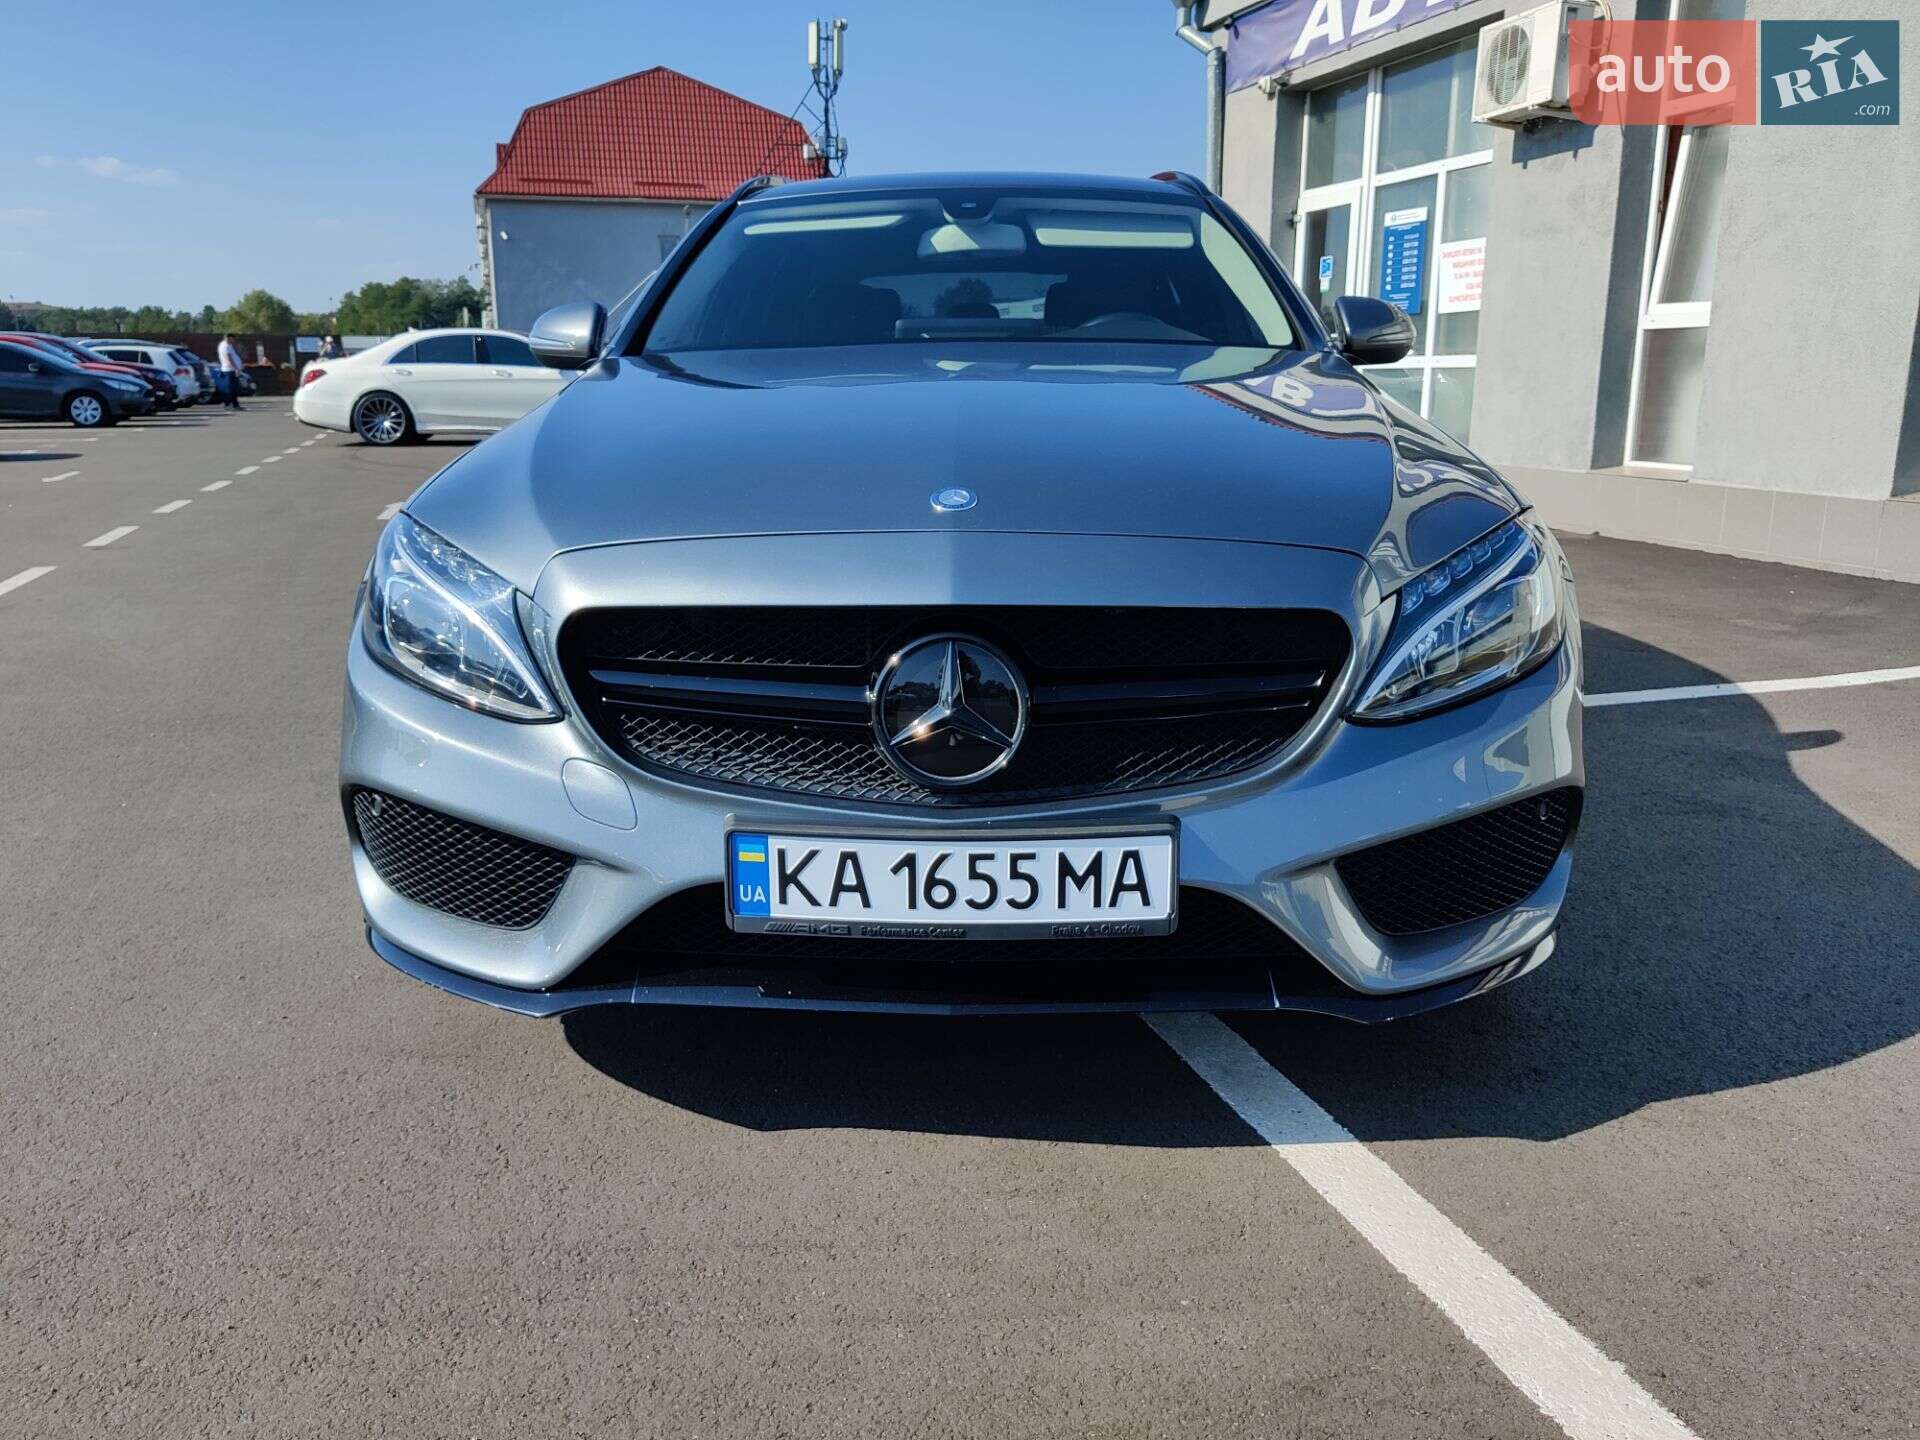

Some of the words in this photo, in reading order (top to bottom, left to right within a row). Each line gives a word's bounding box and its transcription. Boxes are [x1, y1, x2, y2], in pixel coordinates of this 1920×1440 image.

[776, 847, 872, 909] KA
[889, 851, 1040, 910] 1655
[1057, 849, 1152, 909] MA
[739, 884, 767, 903] UA
[788, 923, 852, 936] AMG
[860, 926, 926, 938] Performance
